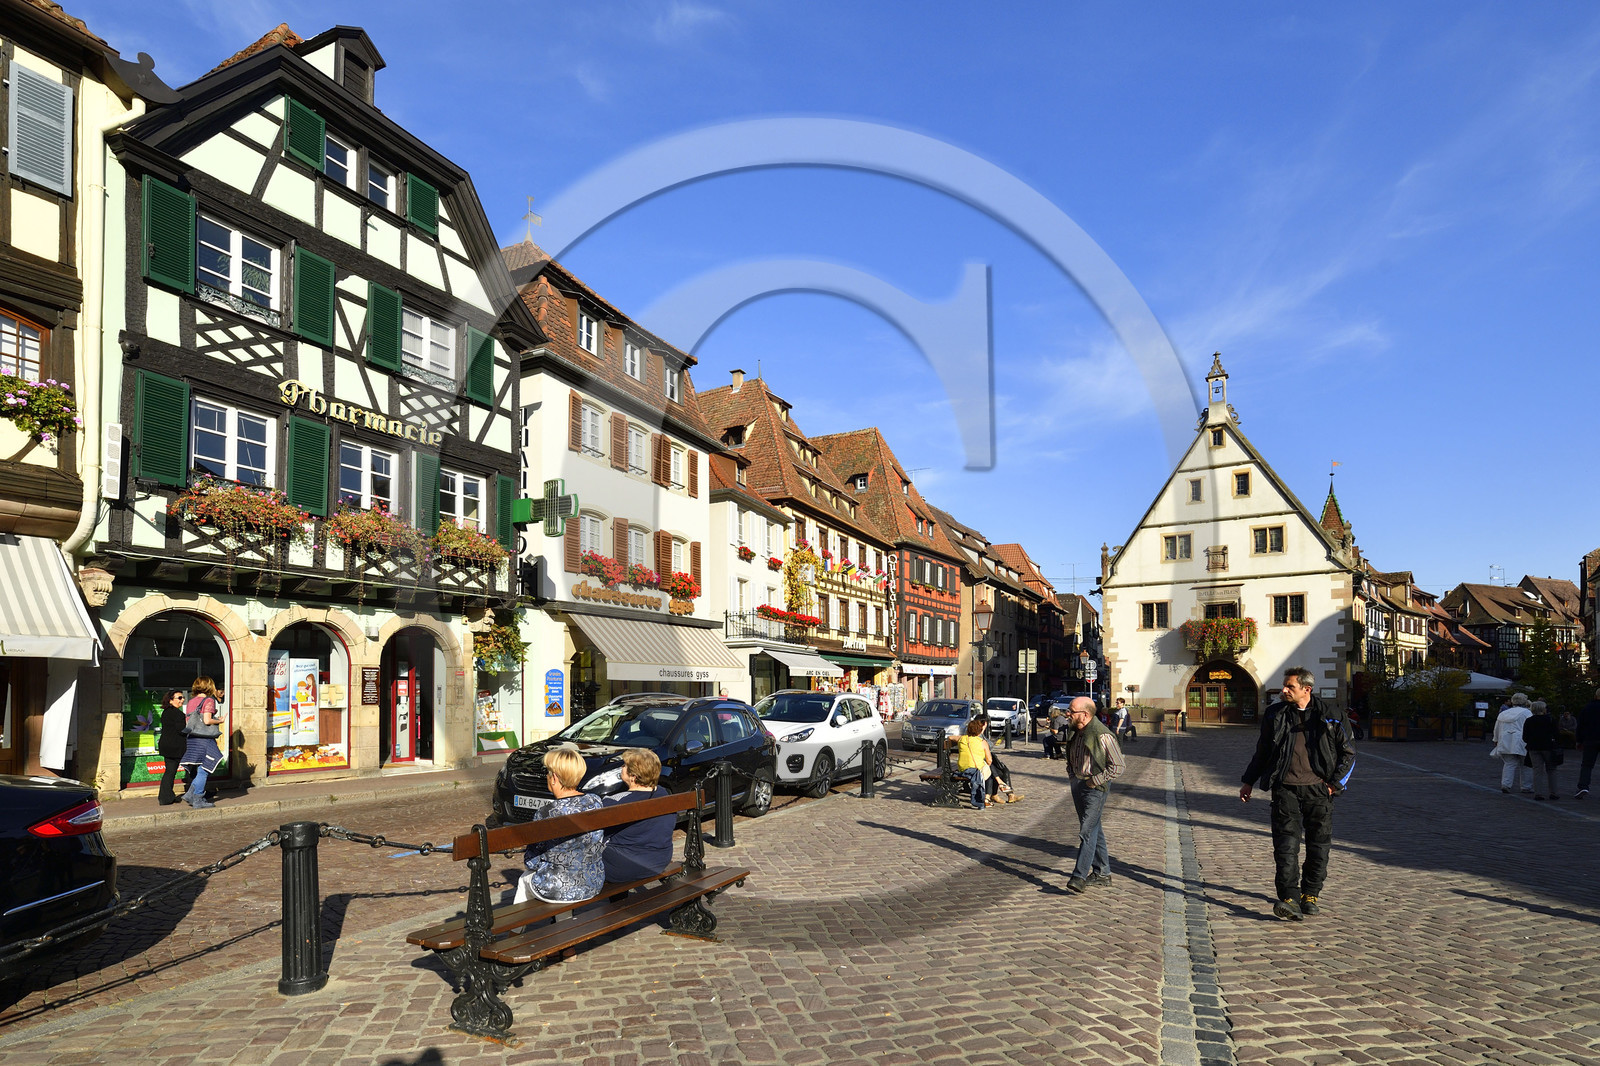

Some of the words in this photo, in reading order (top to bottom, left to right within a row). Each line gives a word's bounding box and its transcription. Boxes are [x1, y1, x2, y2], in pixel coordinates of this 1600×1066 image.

[278, 379, 443, 447] Pharmacie
[659, 668, 694, 678] chaussures
[695, 671, 710, 680] gyss
